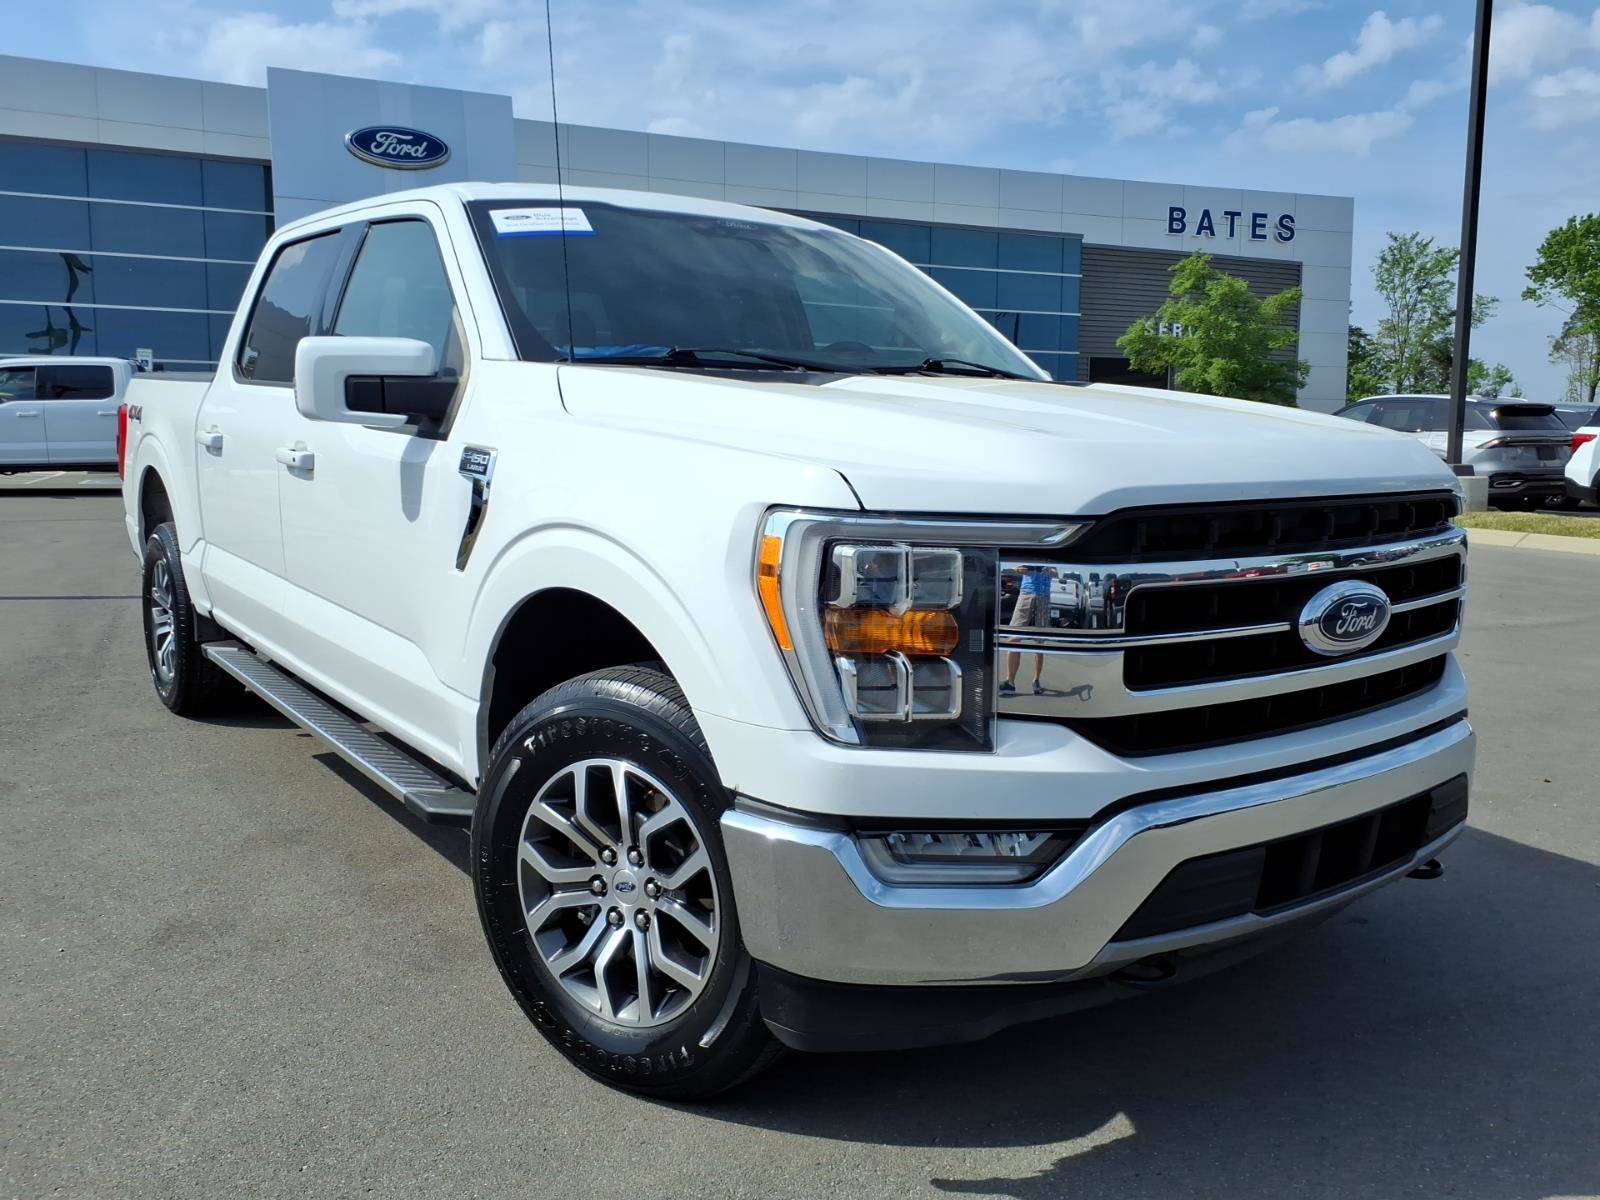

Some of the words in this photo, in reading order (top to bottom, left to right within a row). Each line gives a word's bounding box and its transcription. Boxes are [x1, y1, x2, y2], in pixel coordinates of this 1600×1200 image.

[371, 132, 428, 157] Ford
[1168, 206, 1296, 242] BATES
[1336, 602, 1378, 635] Ford
